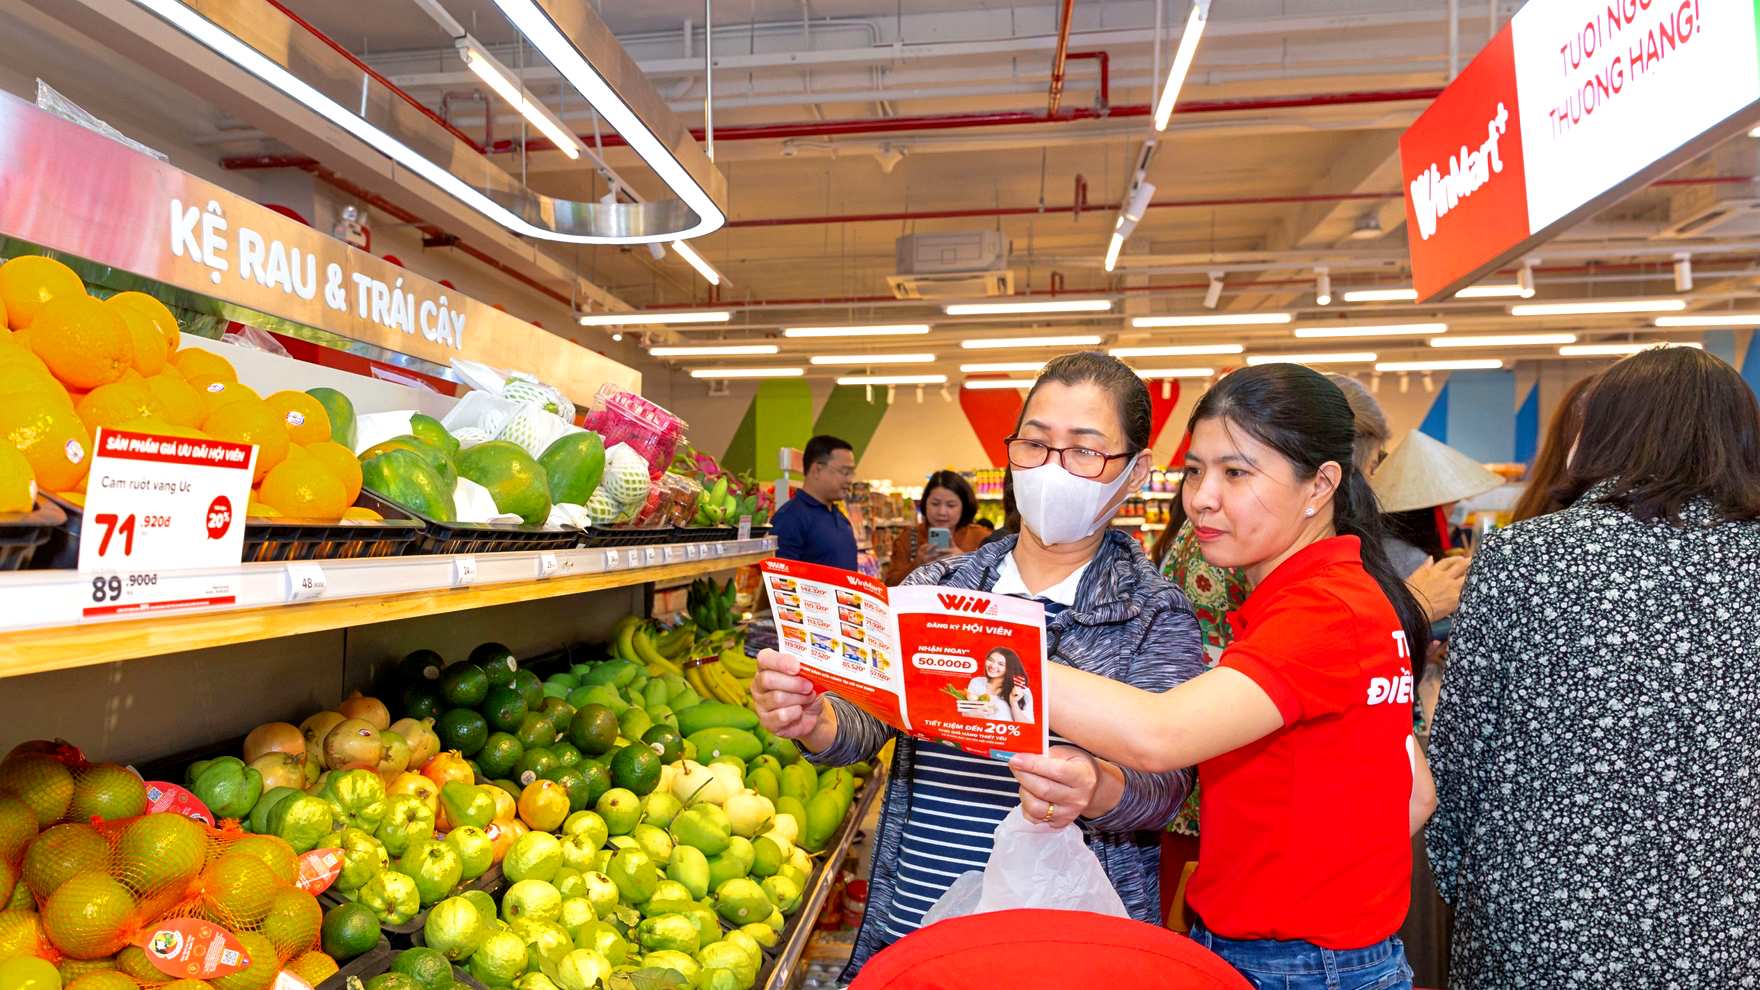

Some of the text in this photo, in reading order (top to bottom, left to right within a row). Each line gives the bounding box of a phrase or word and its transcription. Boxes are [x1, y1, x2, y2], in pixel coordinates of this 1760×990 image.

[170, 199, 465, 350] KỆ RAU & TRÁI CÂY
[102, 476, 126, 488] Cam
[962, 623, 983, 634] HỘI
[985, 625, 1013, 637] VIÊN
[918, 645, 942, 654] NHẬN
[918, 657, 972, 669] 50.000Đ
[984, 722, 1021, 737] 20%
